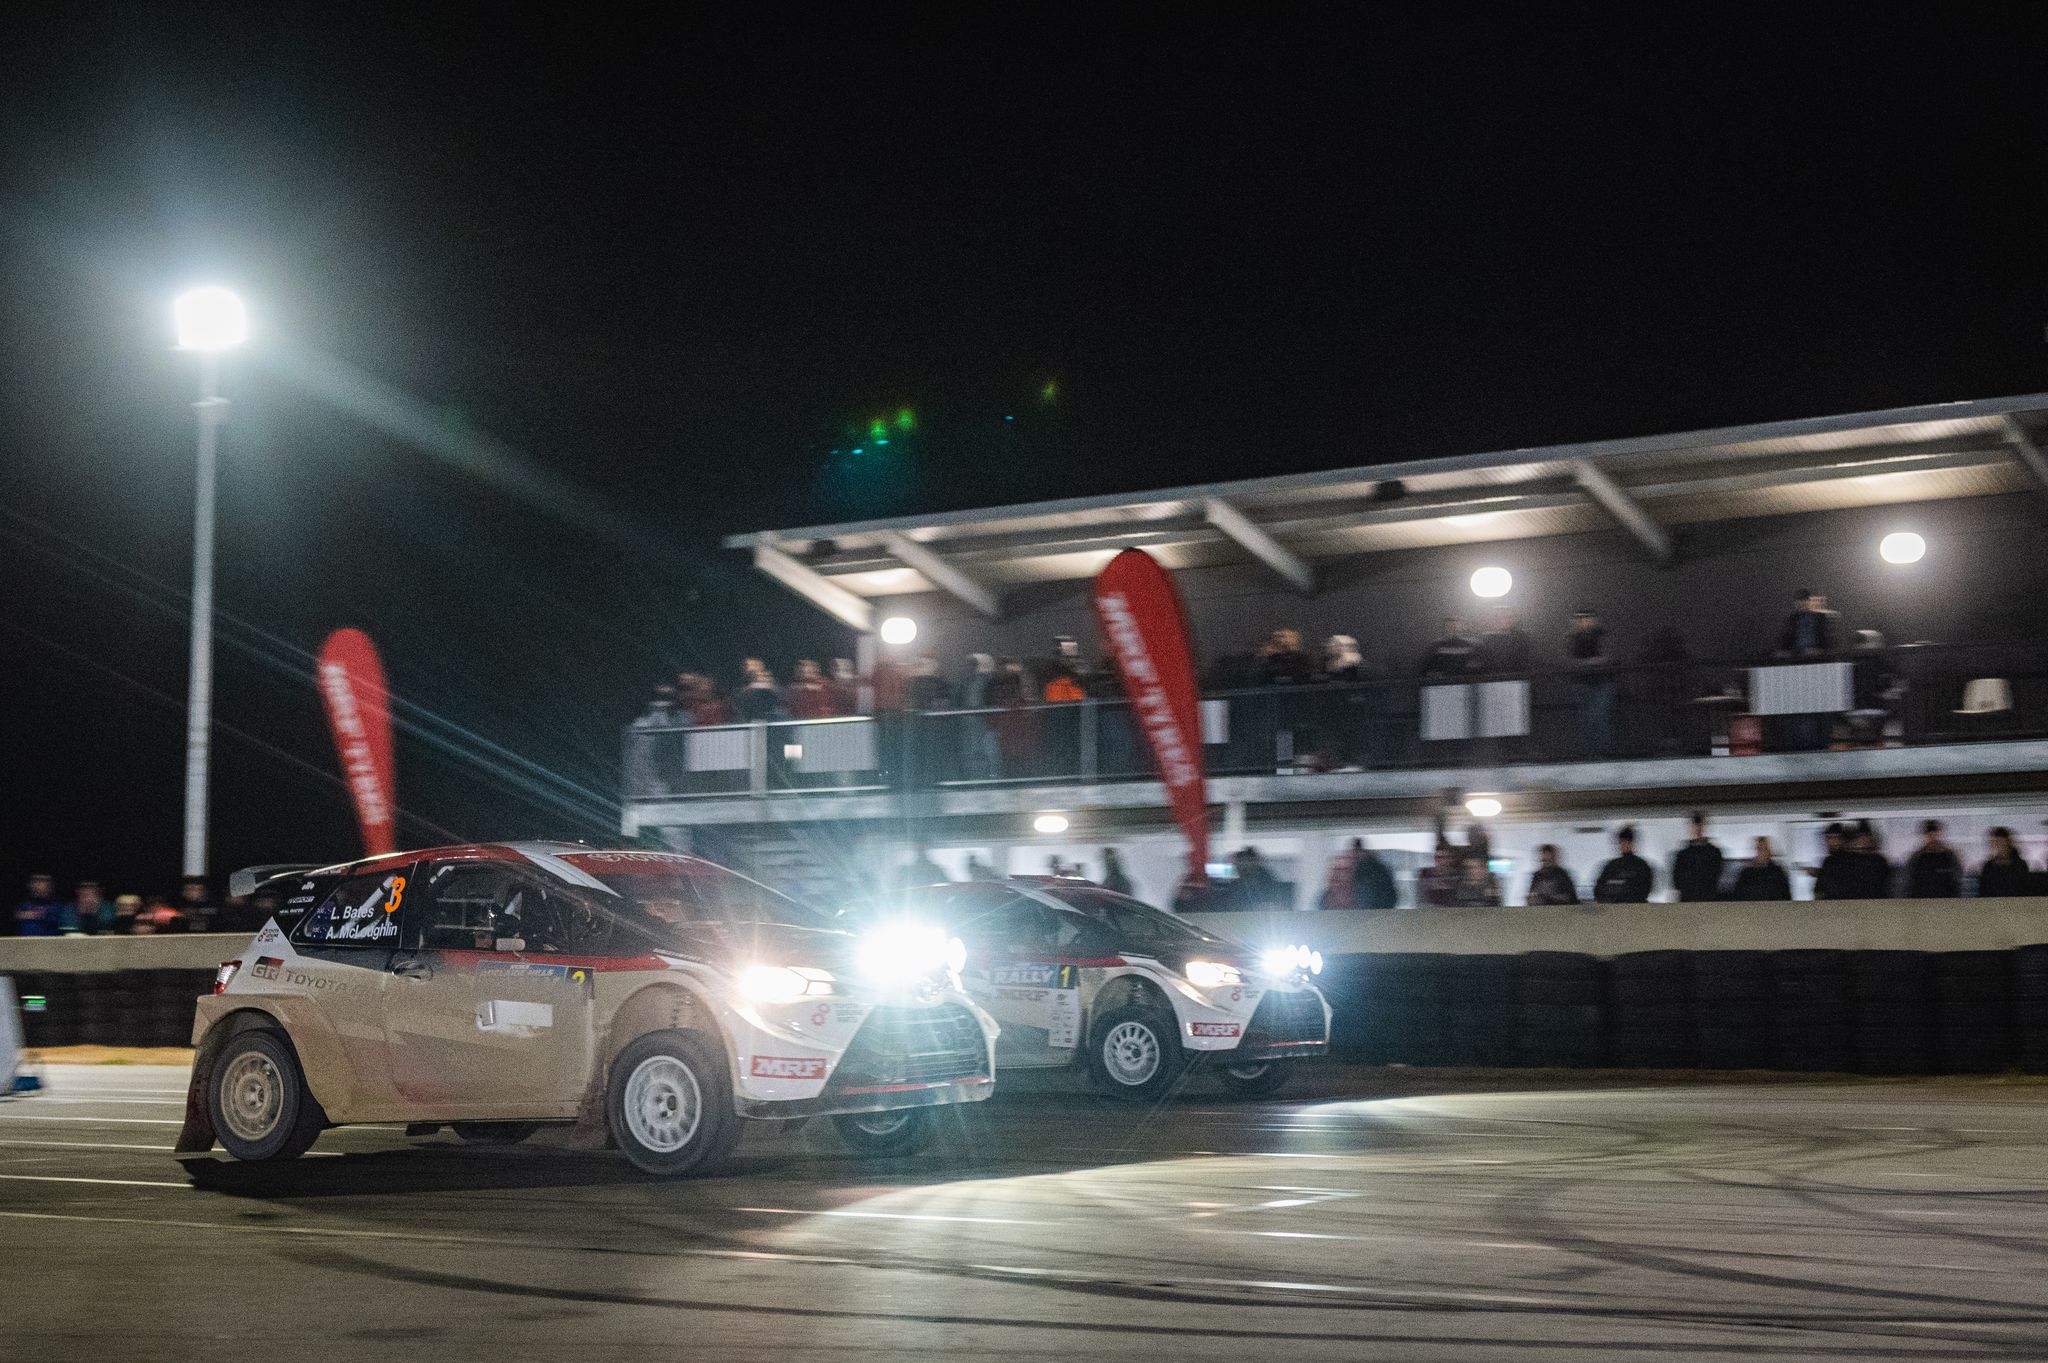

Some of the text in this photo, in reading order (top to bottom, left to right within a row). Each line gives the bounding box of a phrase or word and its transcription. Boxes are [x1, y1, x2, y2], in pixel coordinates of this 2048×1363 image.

[384, 876, 406, 913] 3
[331, 905, 375, 920] L. Bates
[326, 923, 398, 941] A. McLoughlin
[252, 963, 280, 980] GR
[285, 968, 348, 992] TOYOTA
[994, 970, 1055, 984] RALLY
[1060, 966, 1071, 988] 1
[1196, 1024, 1239, 1036] MRF
[754, 1058, 823, 1076] MRF
